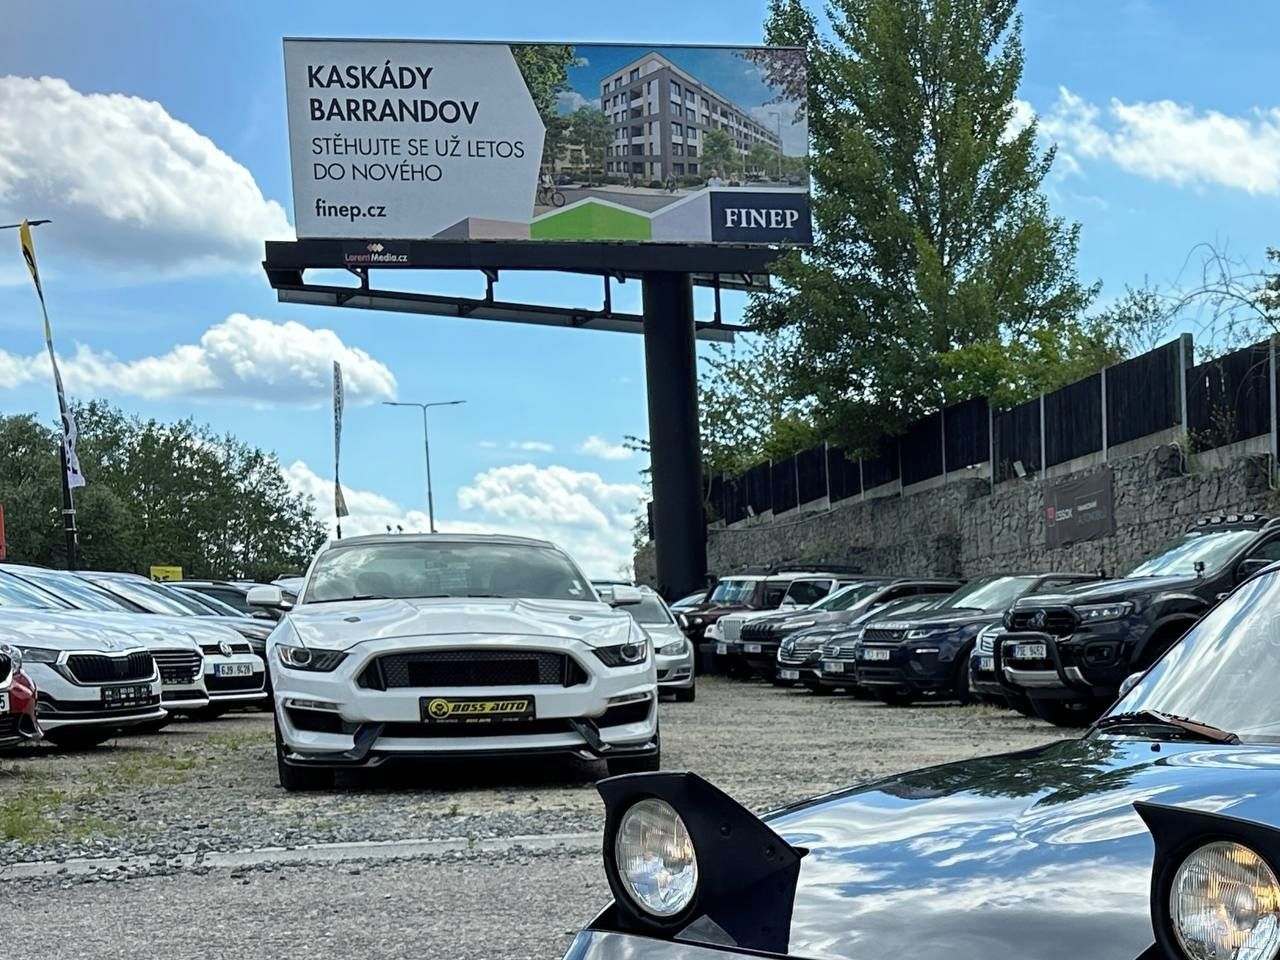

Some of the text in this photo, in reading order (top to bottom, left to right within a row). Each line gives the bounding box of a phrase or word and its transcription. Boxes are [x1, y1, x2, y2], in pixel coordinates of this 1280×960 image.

[308, 60, 434, 90] KASKÁDY
[310, 98, 479, 125] BARRANDOV
[312, 133, 525, 158] STĚHUJTE SE UŽ LETOS
[313, 160, 443, 182] DO NOVÉHO
[315, 198, 387, 222] finep.cz
[726, 208, 799, 229] FINEP
[451, 701, 526, 713] BOSS AUTO
